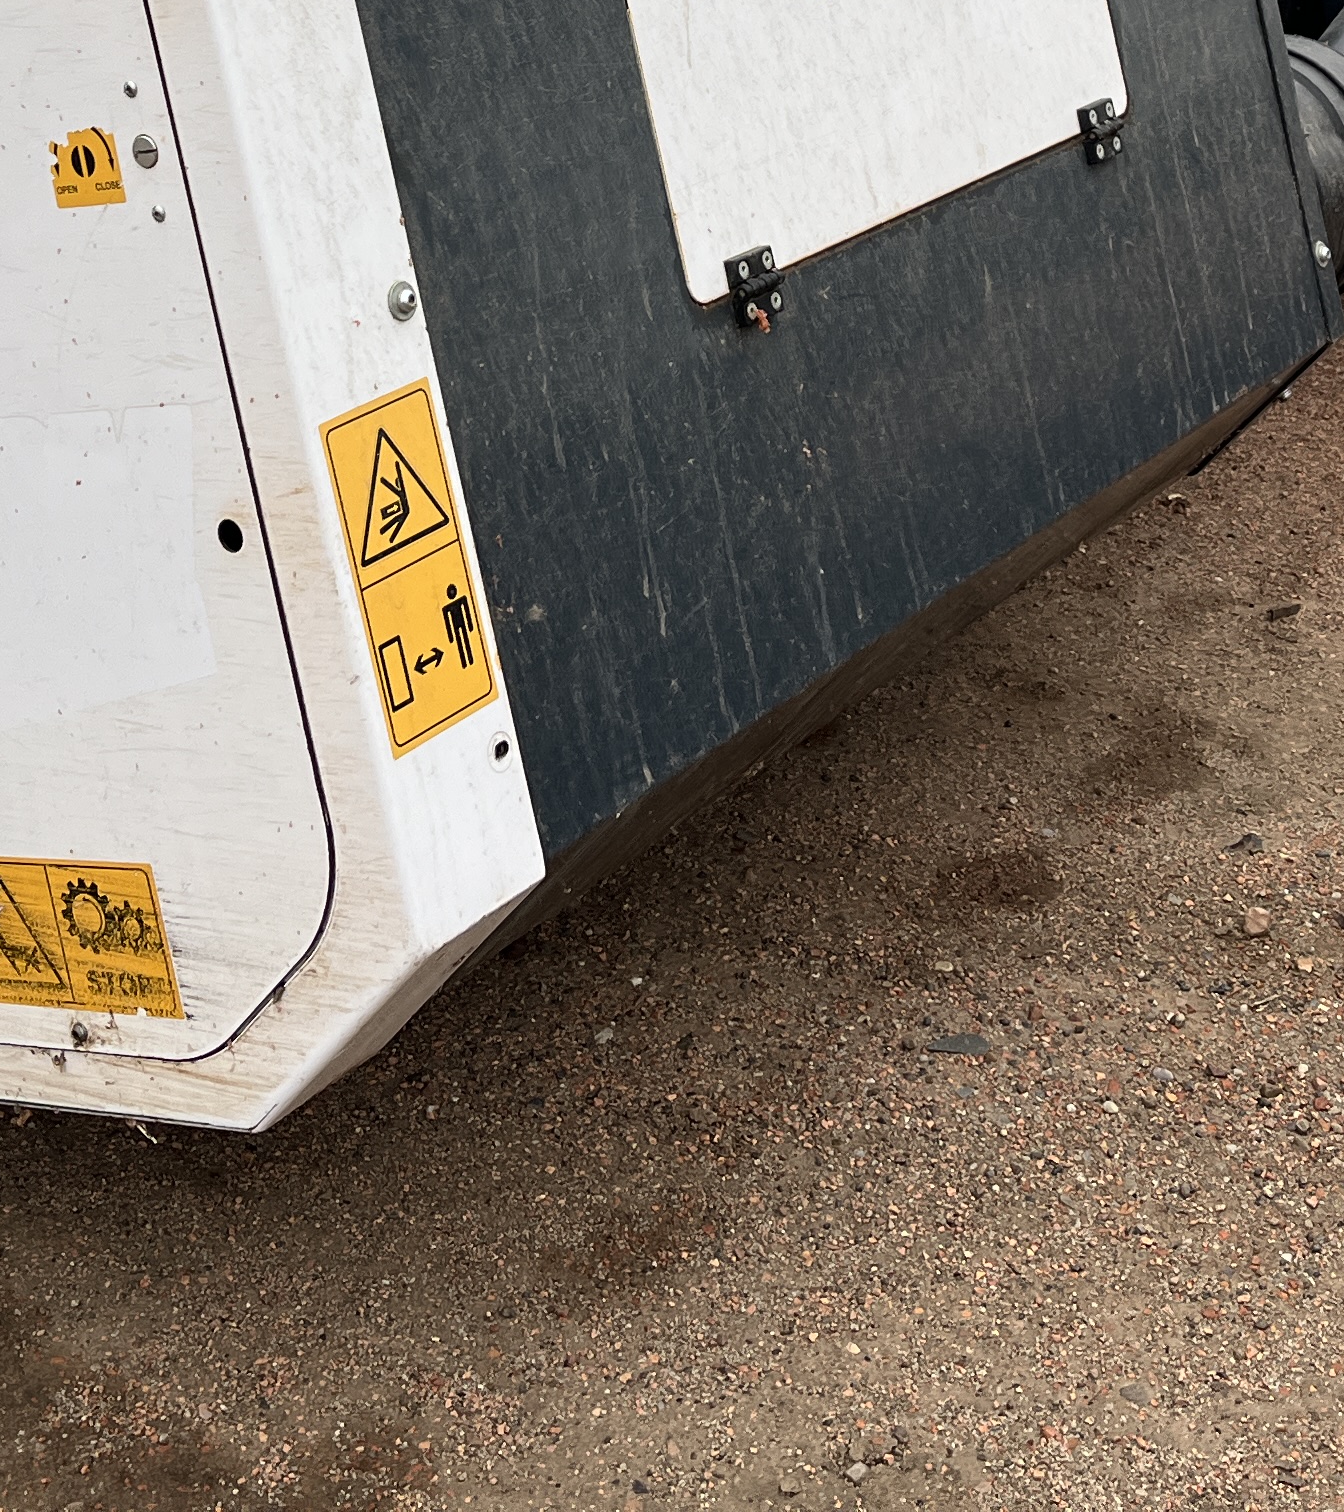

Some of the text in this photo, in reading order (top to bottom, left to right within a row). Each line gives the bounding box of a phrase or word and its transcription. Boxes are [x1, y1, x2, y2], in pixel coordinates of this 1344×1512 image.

[56, 180, 122, 195] OPEN CLOSE
[86, 969, 152, 998] STOP
